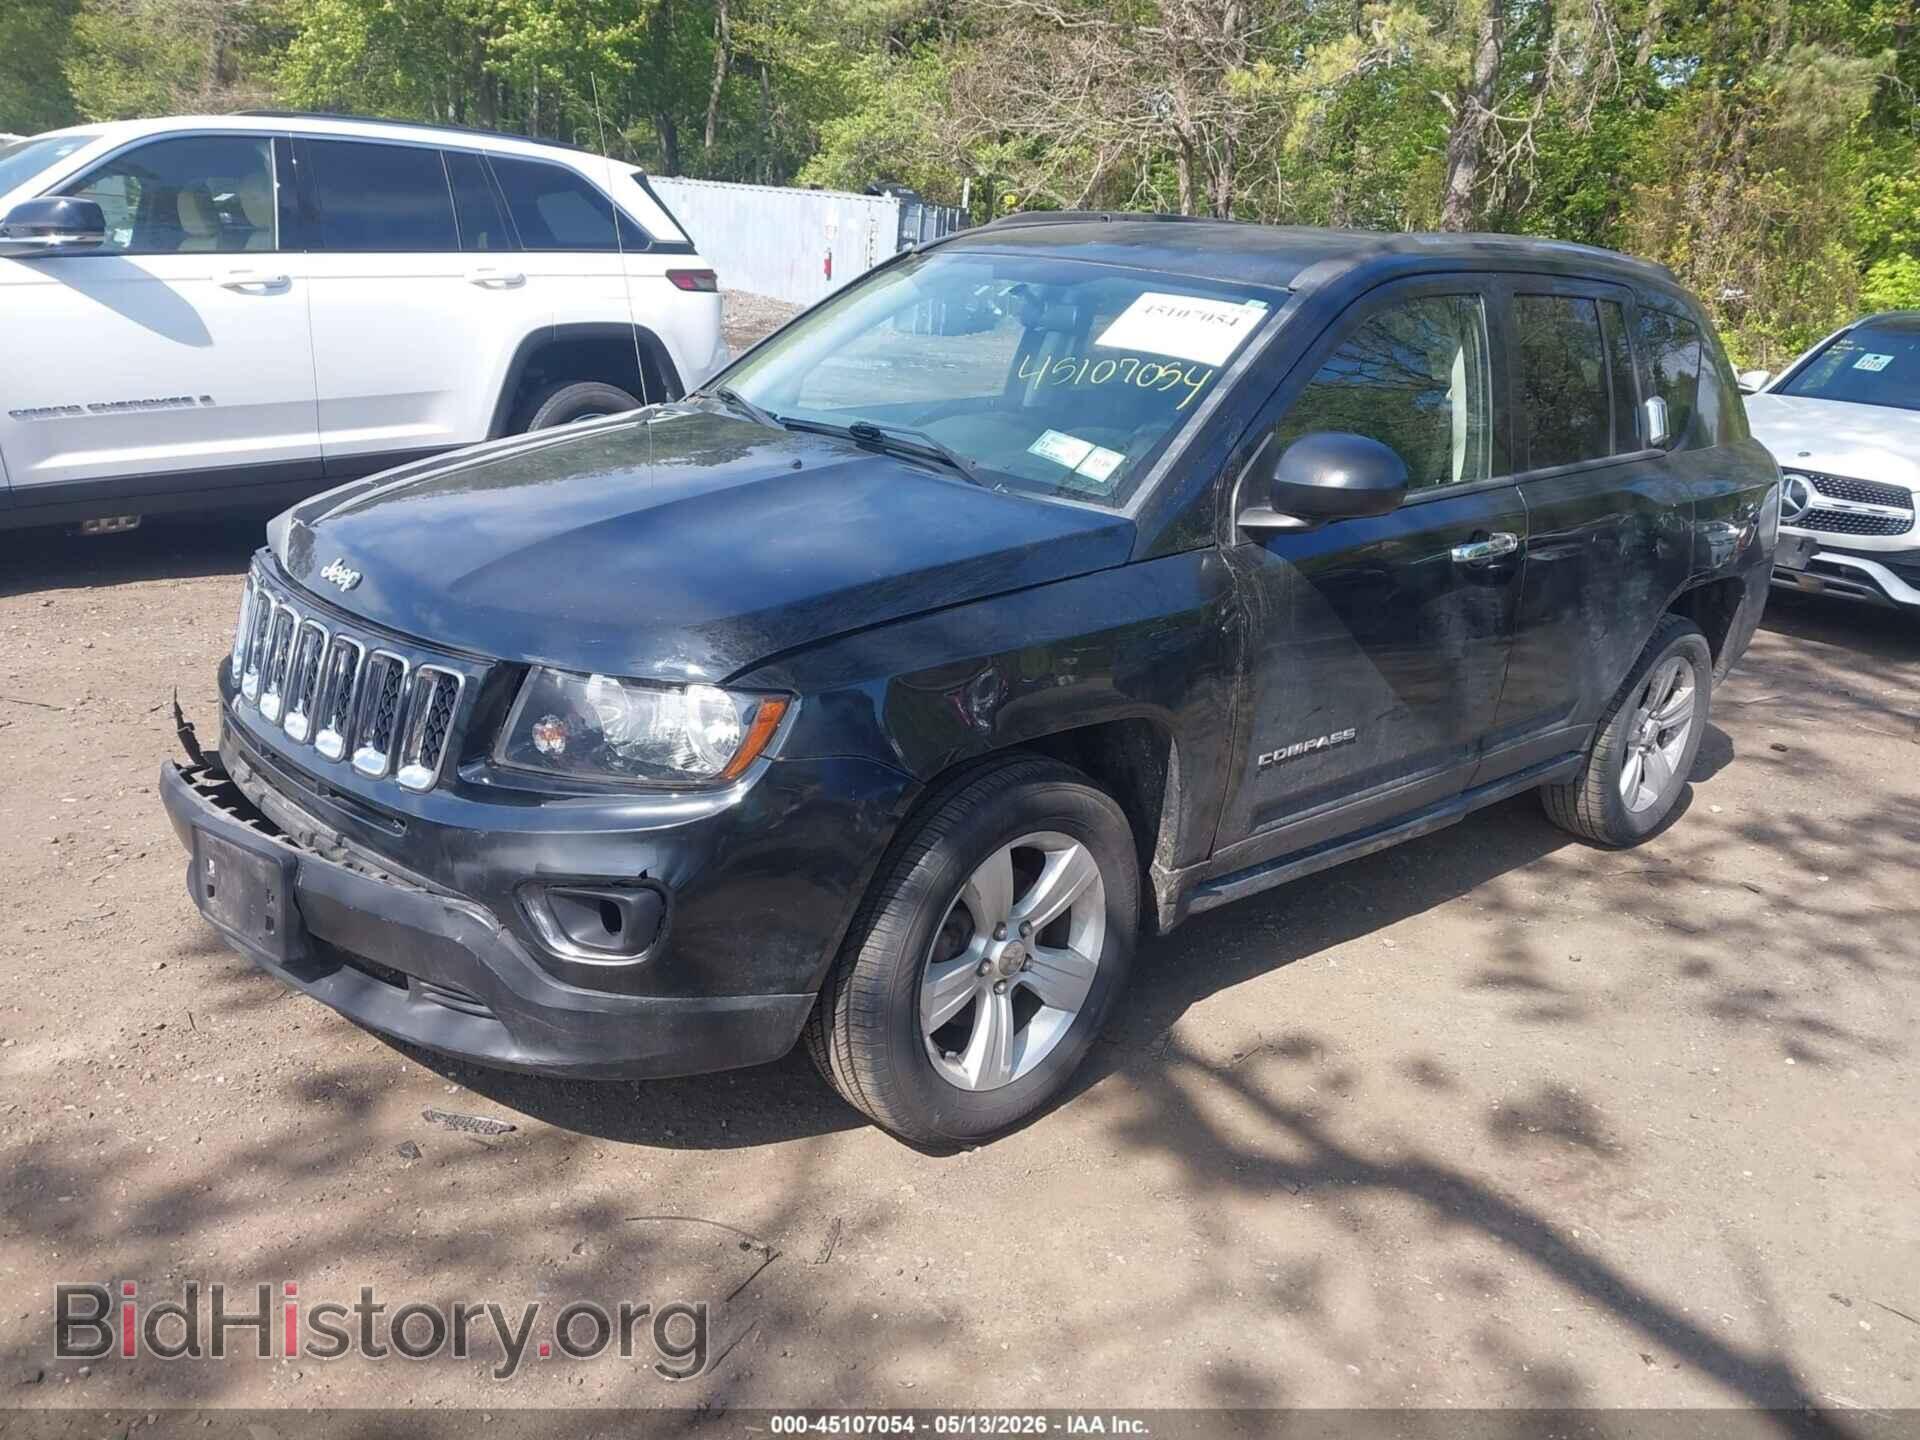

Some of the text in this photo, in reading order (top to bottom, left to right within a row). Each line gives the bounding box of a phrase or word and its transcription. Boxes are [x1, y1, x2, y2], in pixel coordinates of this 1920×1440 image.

[1018, 354, 1213, 410] 45107054
[320, 558, 362, 593] Jeep
[1258, 728, 1356, 766] COMPASS
